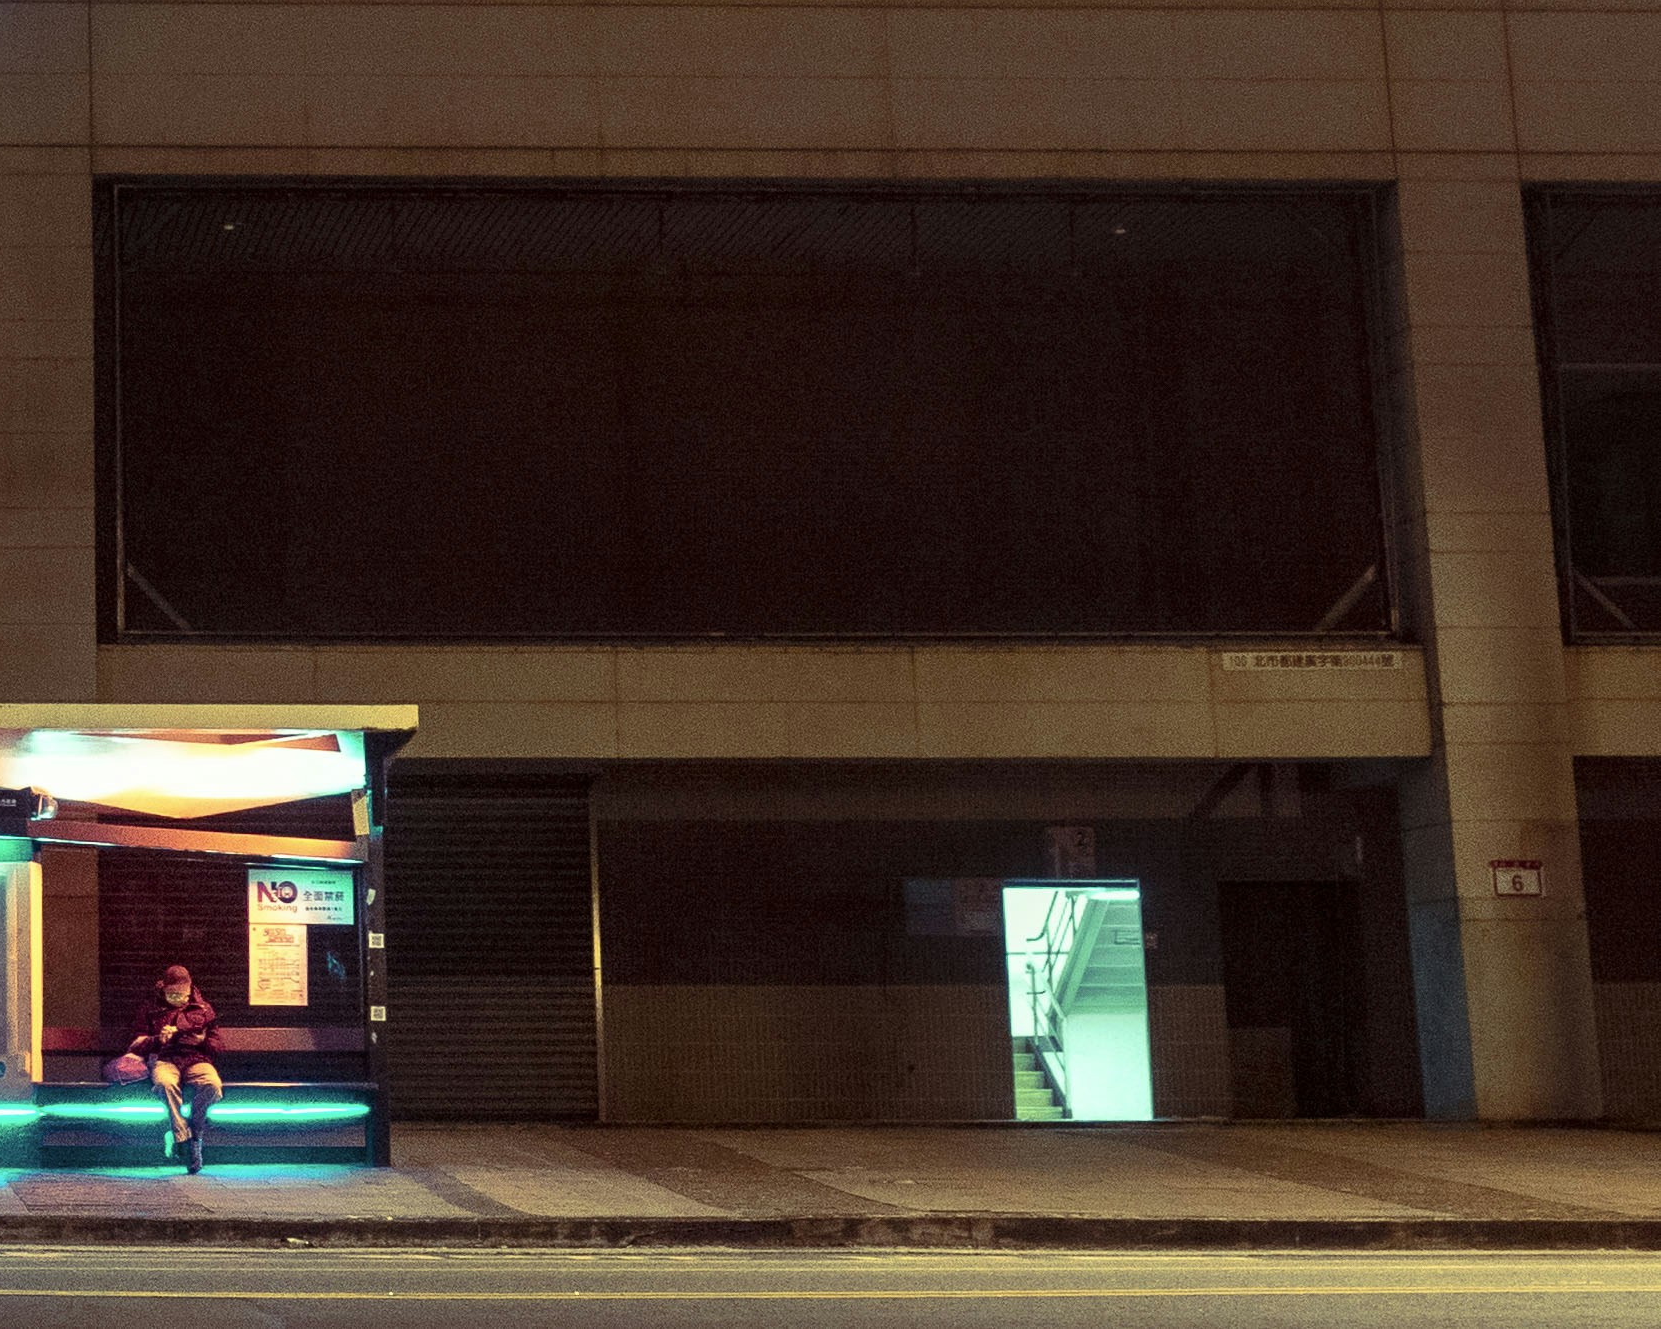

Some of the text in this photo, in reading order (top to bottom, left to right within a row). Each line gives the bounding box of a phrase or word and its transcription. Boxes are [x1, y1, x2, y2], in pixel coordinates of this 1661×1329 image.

[257, 881, 298, 903] NO
[1512, 875, 1524, 892] 6
[257, 904, 298, 913] Smoking
